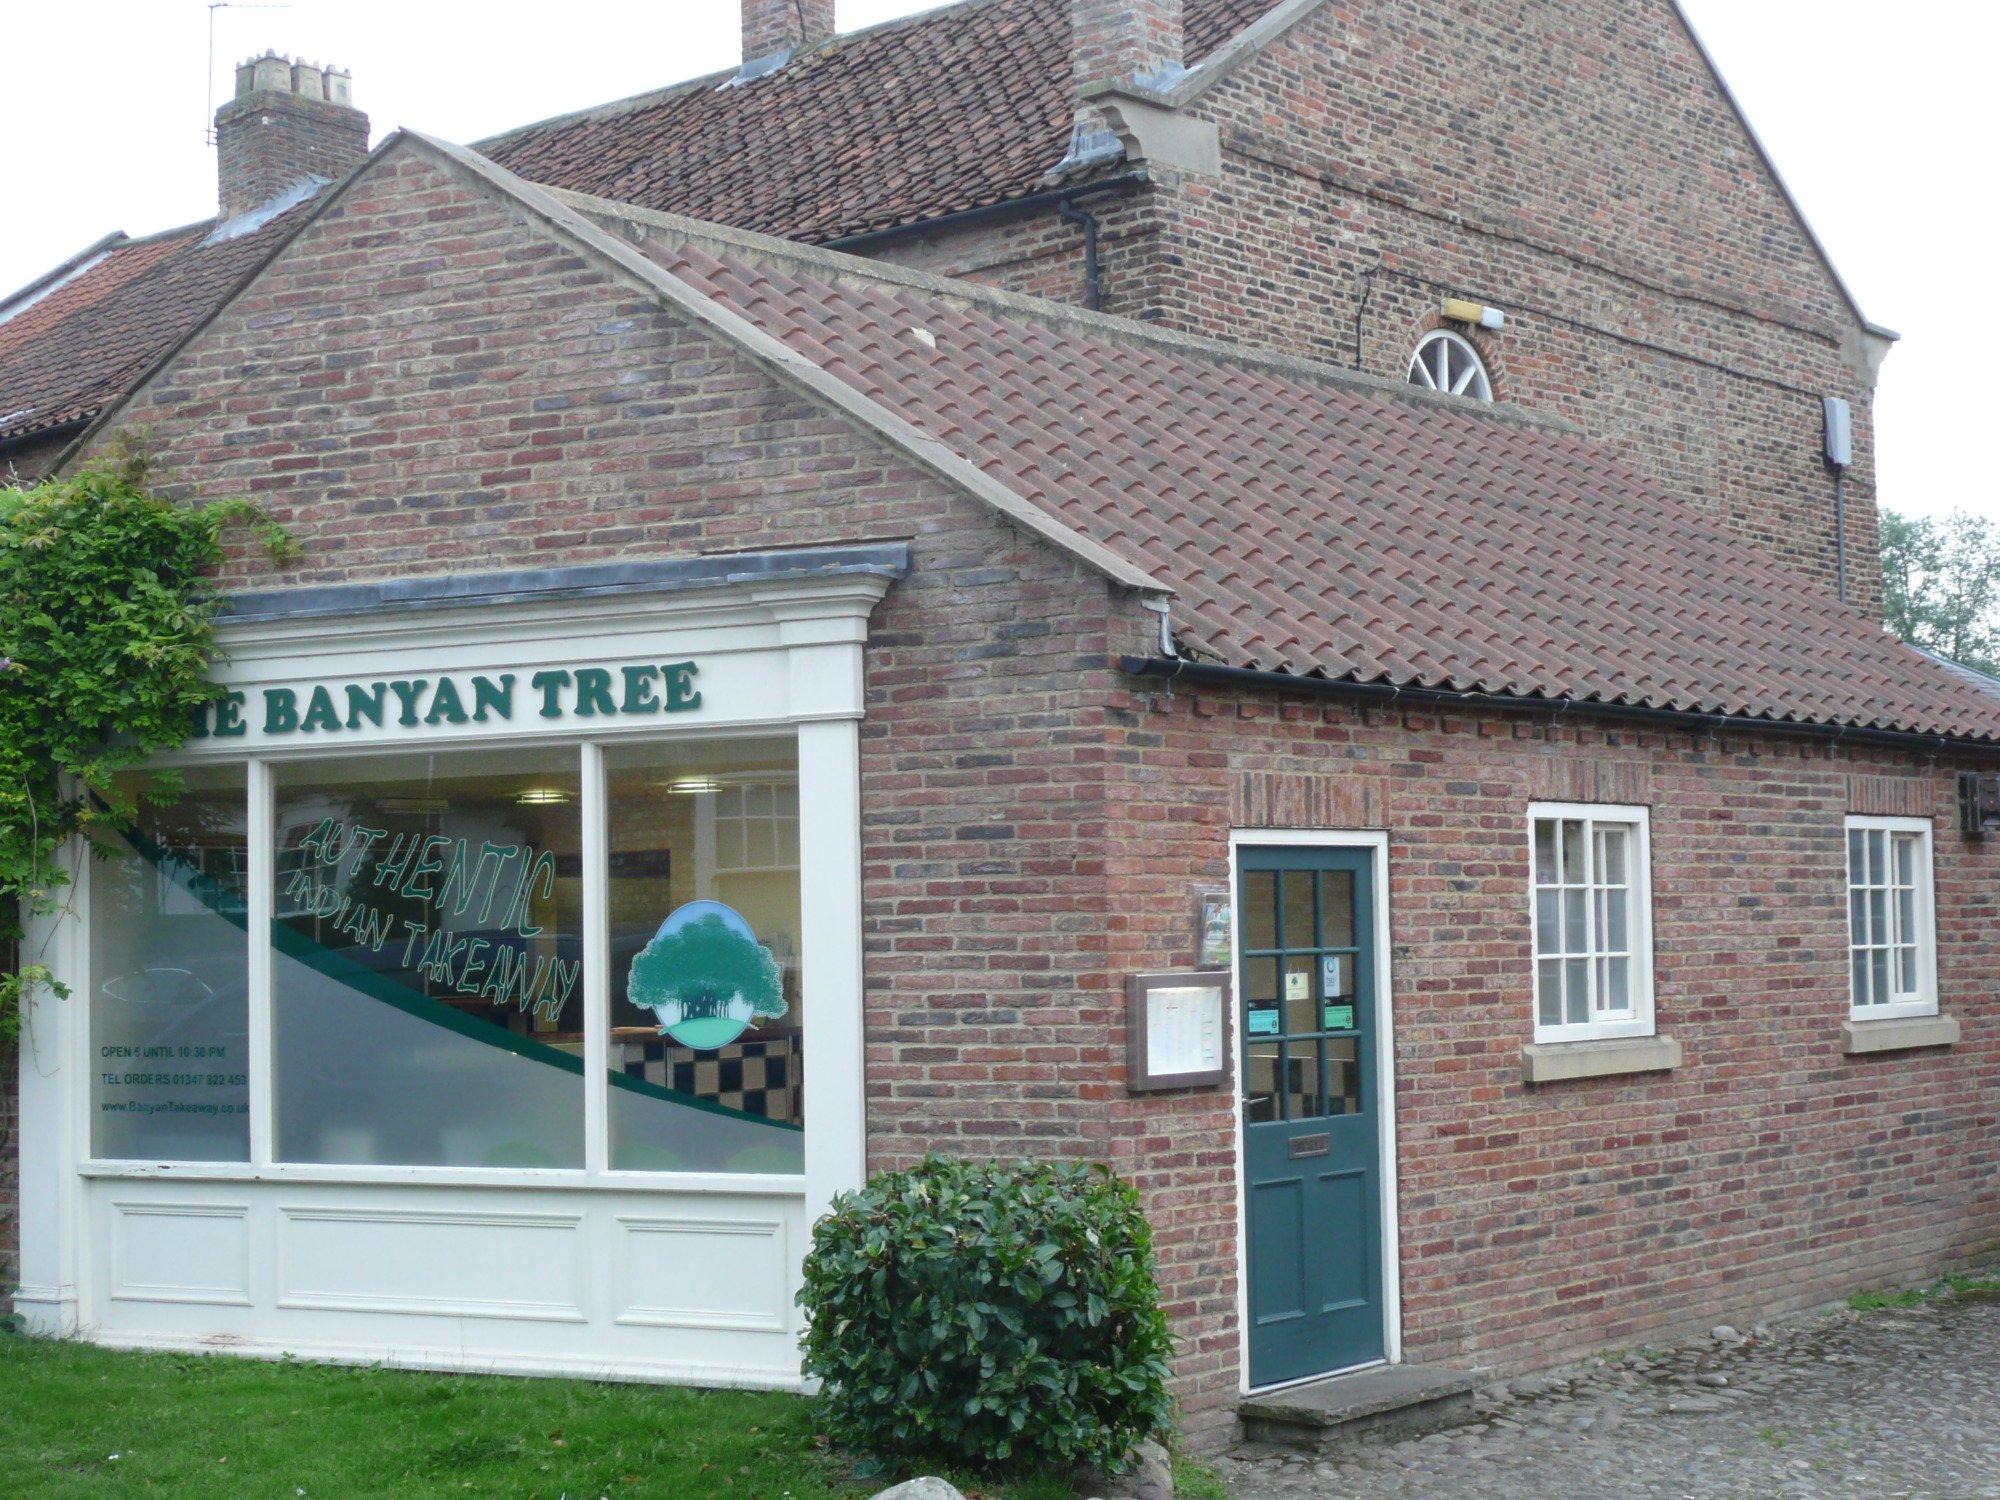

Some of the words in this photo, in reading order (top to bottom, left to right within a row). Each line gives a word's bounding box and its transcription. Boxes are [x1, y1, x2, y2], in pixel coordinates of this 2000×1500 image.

[262, 673, 516, 735] BANYAN
[531, 659, 703, 718] TREE
[299, 816, 555, 937] AUTHENTIC
[286, 869, 393, 952] INDIAN
[402, 919, 580, 1022] TAKEAWAY
[101, 1046, 131, 1058] OPEN
[143, 1046, 175, 1058] UNTIL
[209, 1046, 226, 1058] PM
[101, 1073, 121, 1085] TEL
[124, 1073, 170, 1085] ORDERS
